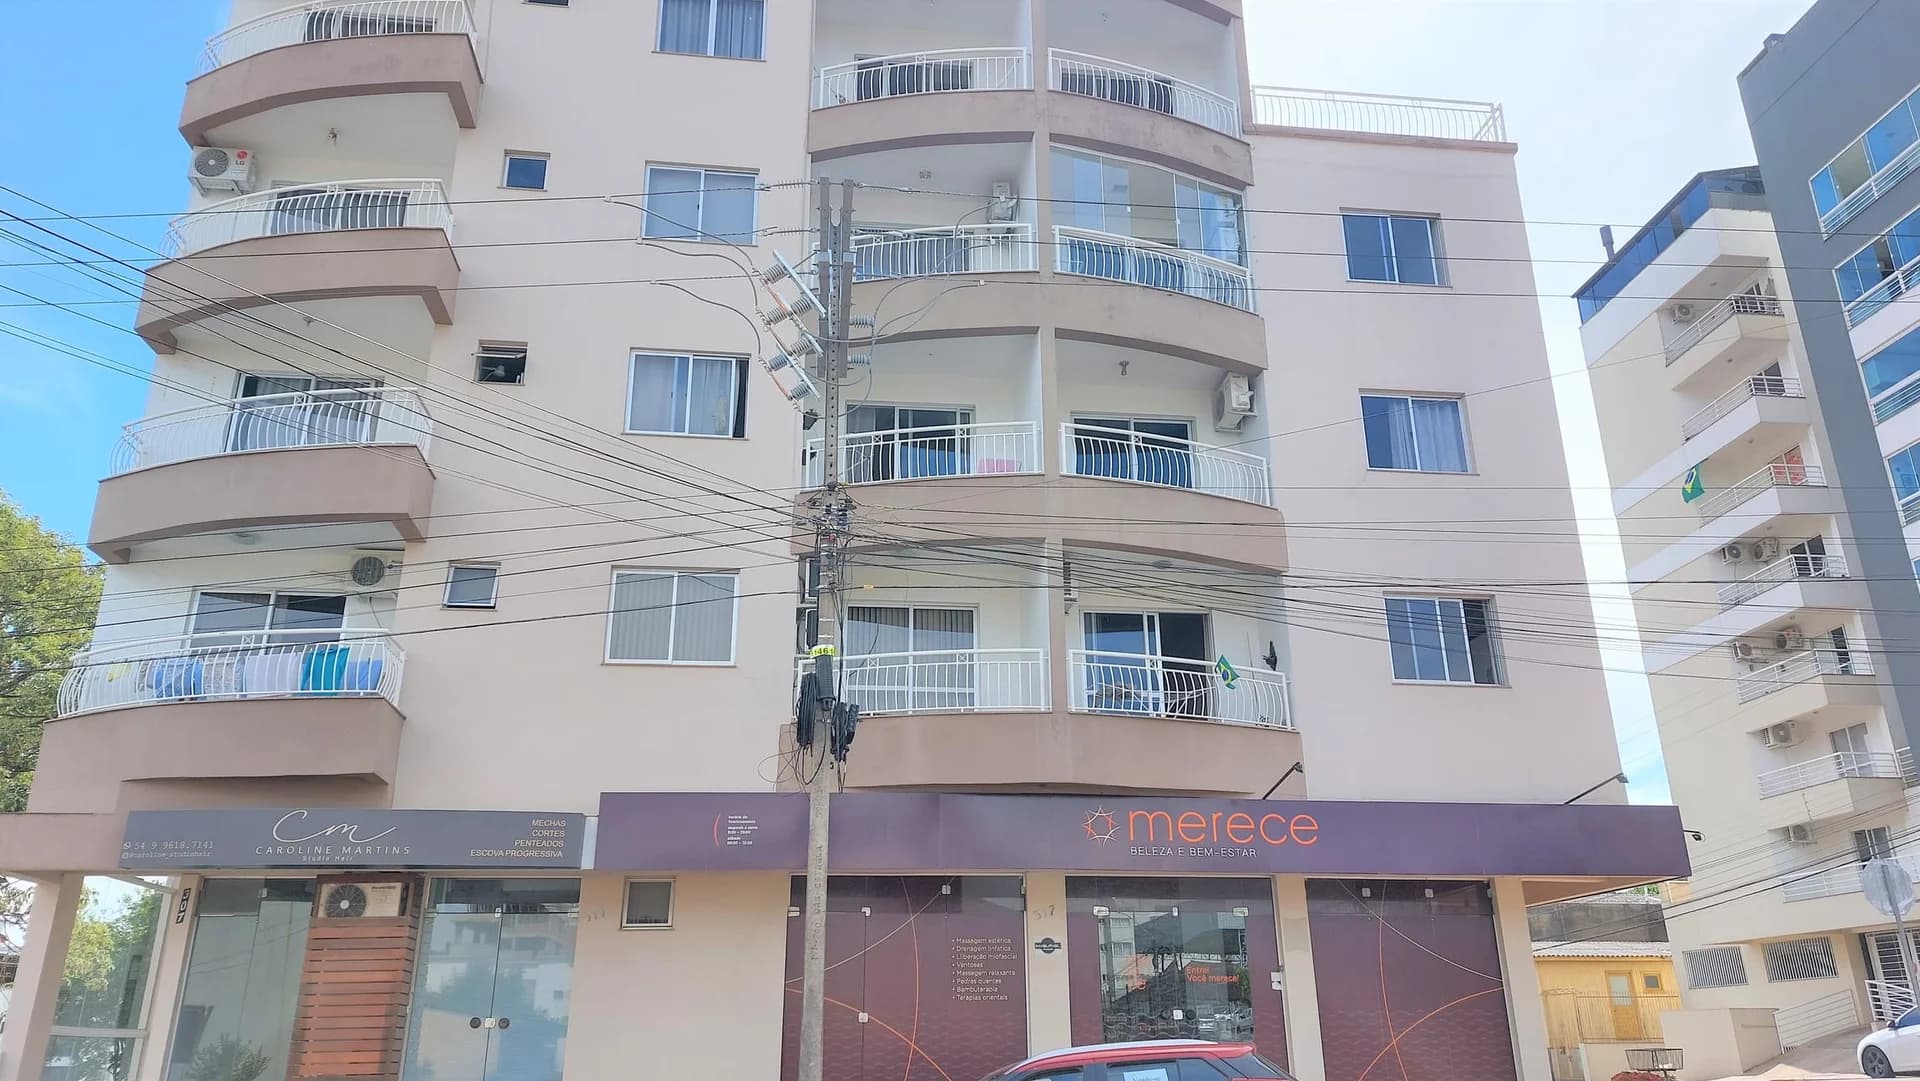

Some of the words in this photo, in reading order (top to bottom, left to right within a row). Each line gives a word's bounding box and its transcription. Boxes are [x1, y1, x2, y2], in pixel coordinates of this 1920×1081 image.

[532, 819, 566, 827] MECHAS
[1128, 810, 1319, 846] merece
[532, 829, 565, 837] CORTES
[134, 841, 145, 850] 54
[151, 841, 157, 850] 9
[514, 839, 564, 848] PENTEADOS
[255, 846, 332, 855] CAROLINE
[342, 846, 410, 855] MARTINS
[470, 849, 504, 857] ESCOVA
[505, 849, 563, 858] PROGRESSIVA
[1130, 847, 1174, 856] BELEZA
[1178, 847, 1185, 857] E
[1189, 847, 1257, 858] BEM-ESTAR
[1208, 974, 1240, 982] merece!
